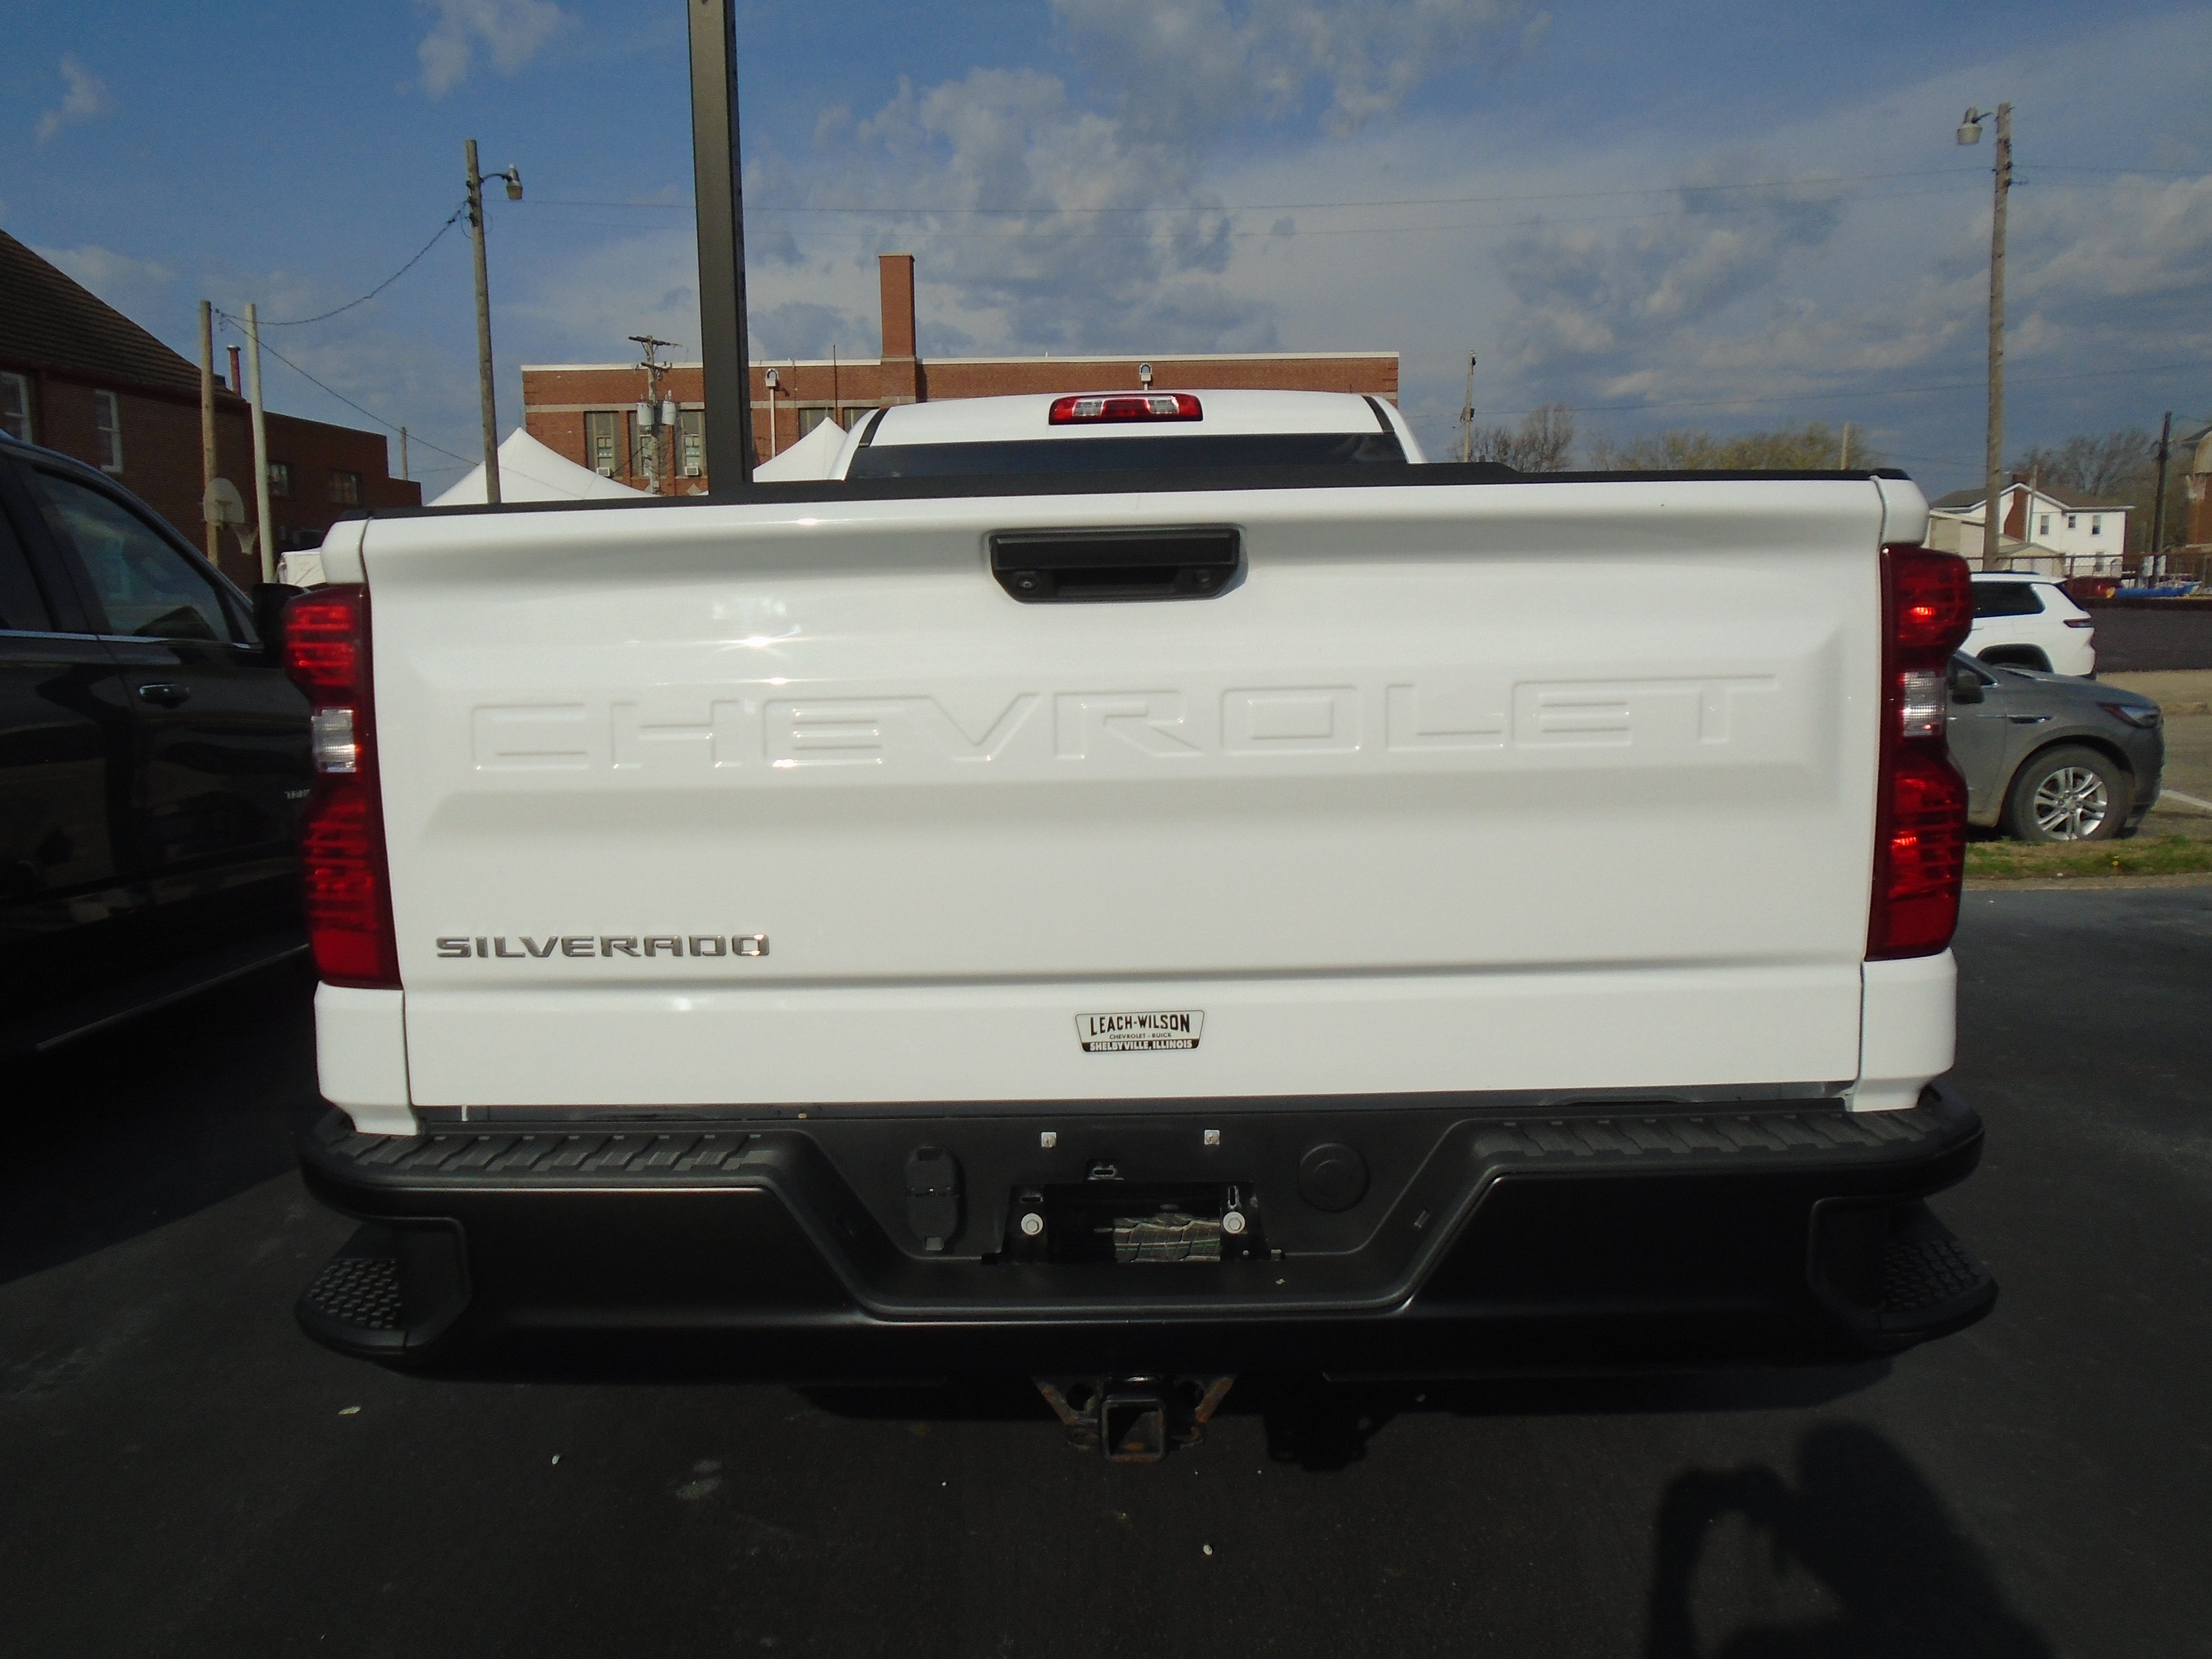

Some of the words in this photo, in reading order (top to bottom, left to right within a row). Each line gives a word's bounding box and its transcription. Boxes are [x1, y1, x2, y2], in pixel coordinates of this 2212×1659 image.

[471, 674, 1778, 771] CHEVROLET
[435, 934, 770, 958] SILVERADO
[1090, 1014, 1190, 1036] LEACH-WILSON
[1153, 1039, 1193, 1049] ILLINOIS
